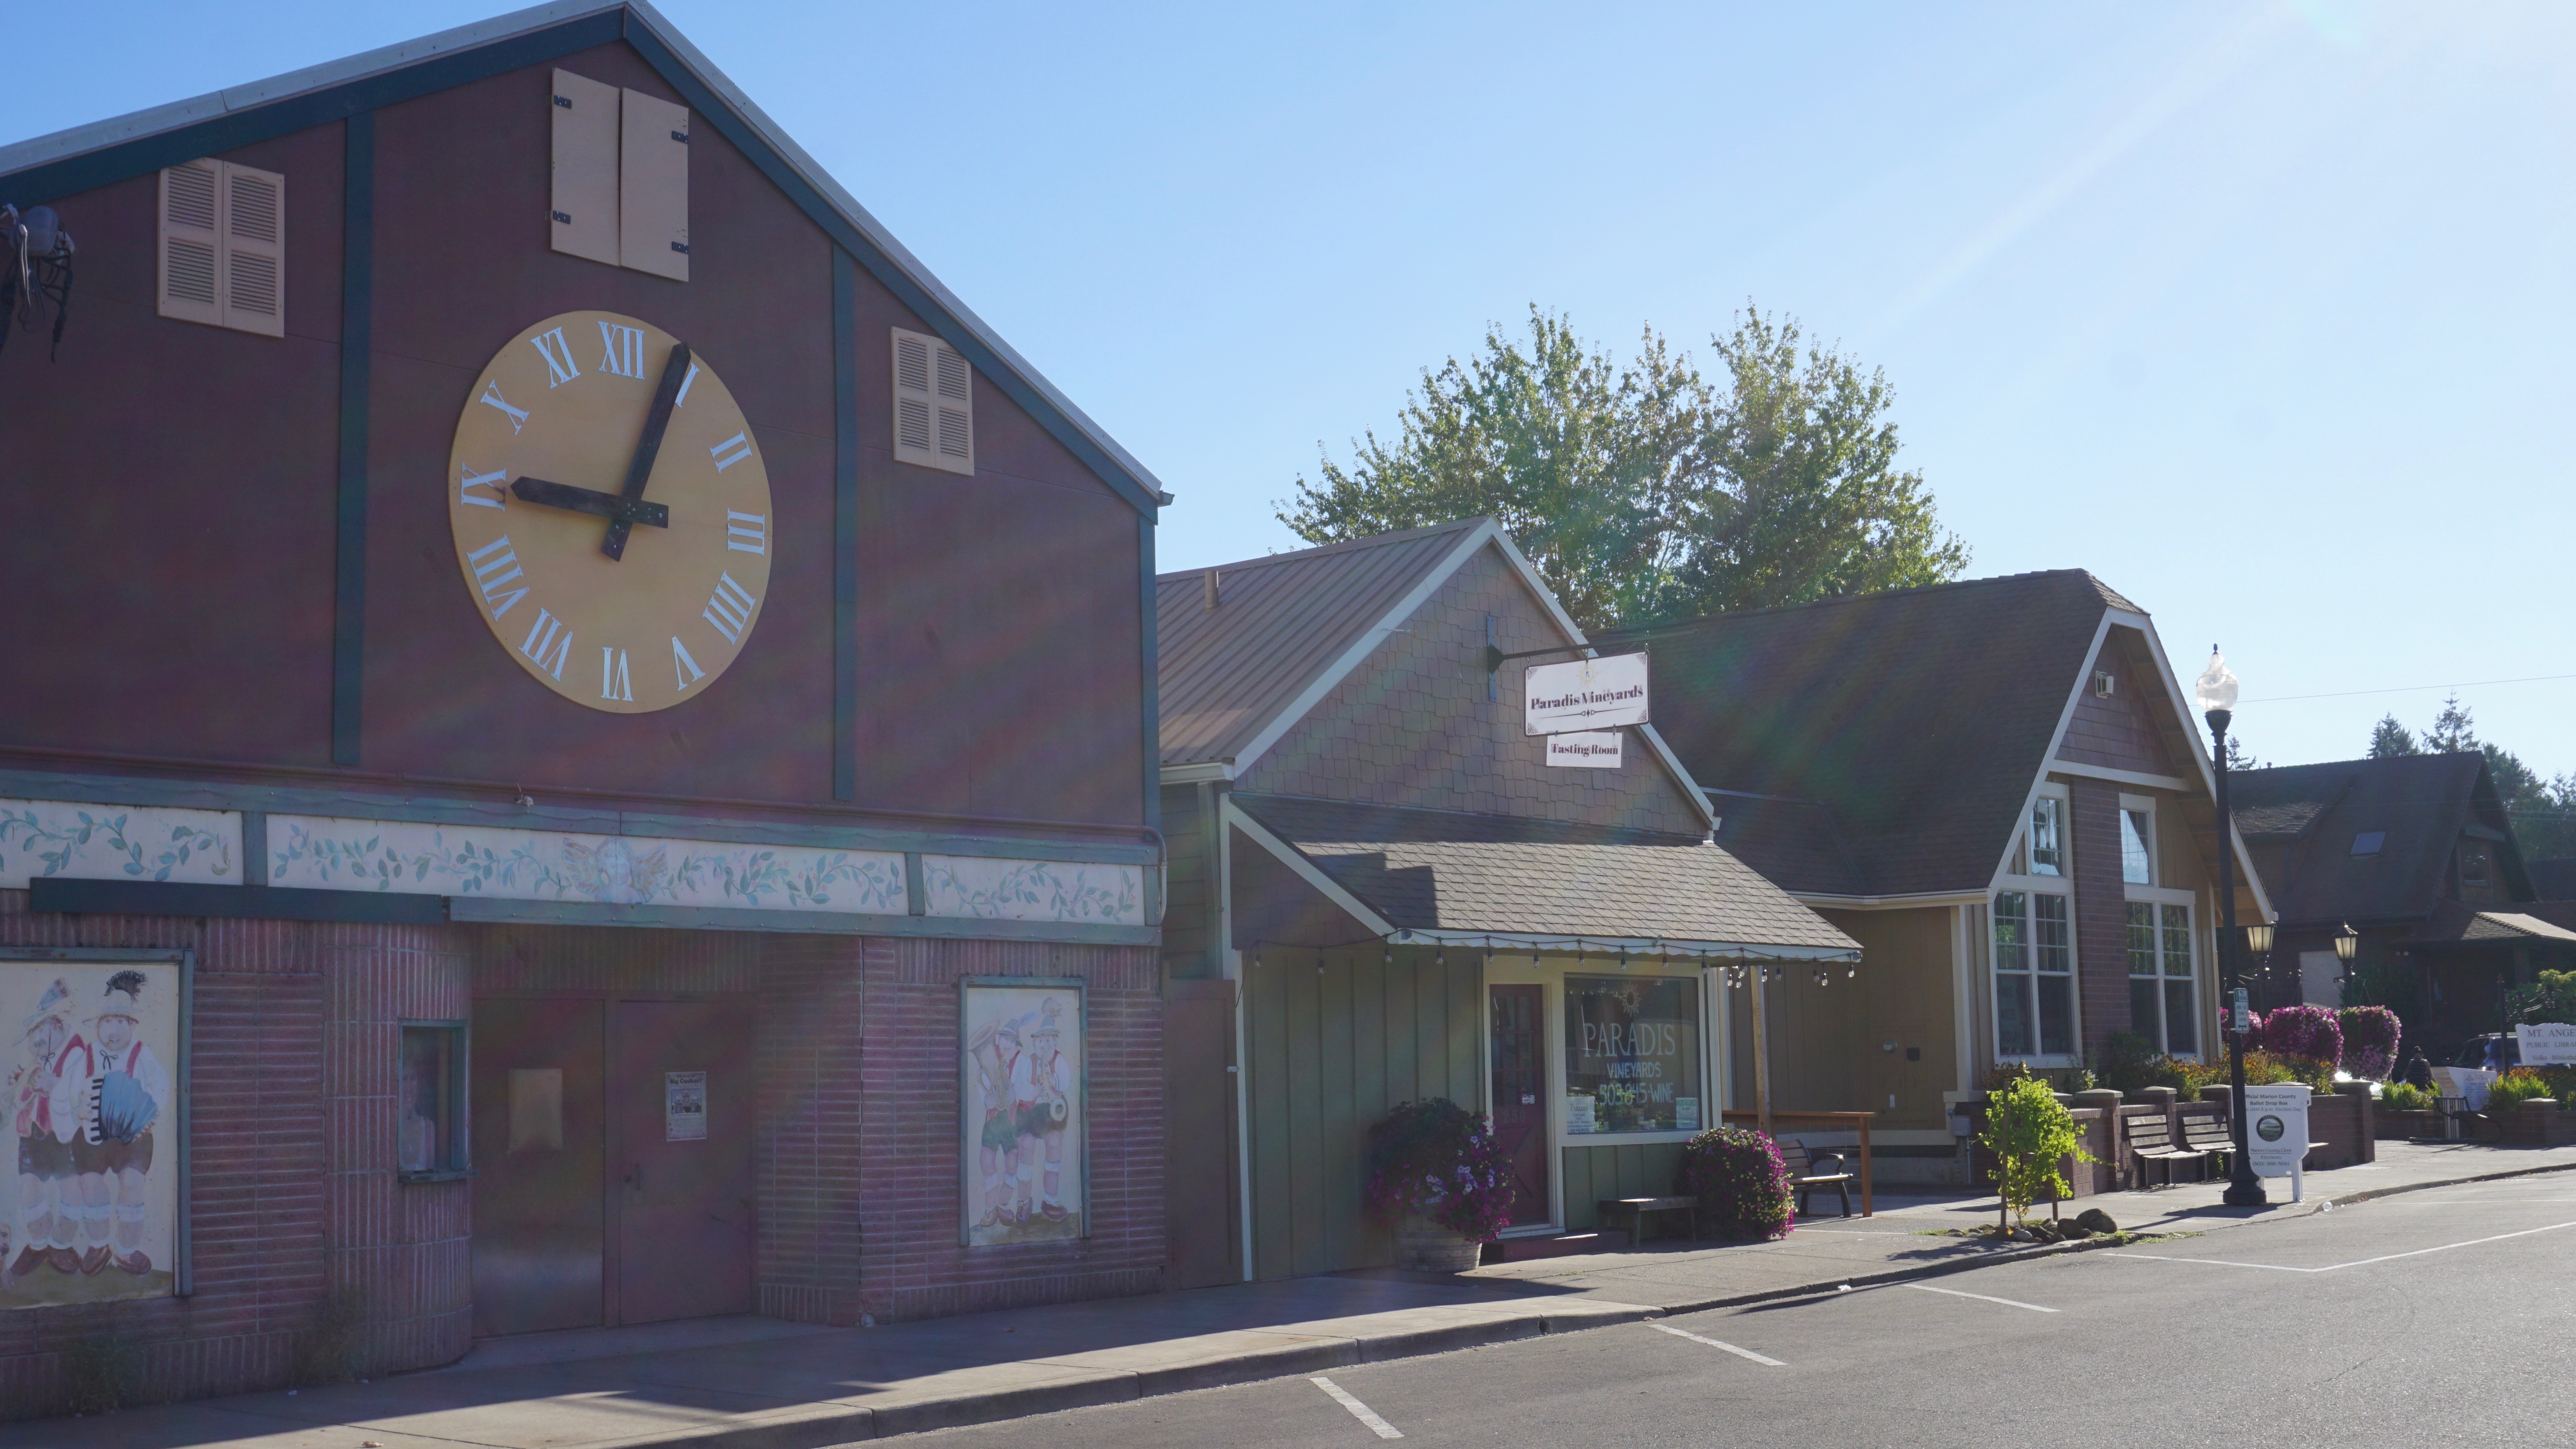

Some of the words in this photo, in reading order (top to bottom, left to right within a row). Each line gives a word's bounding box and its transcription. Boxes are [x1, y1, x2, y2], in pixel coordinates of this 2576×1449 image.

[530, 326, 581, 389] XI
[597, 321, 645, 380] XII
[480, 379, 530, 435] X
[709, 430, 753, 474] II
[461, 462, 506, 512] IX
[727, 508, 765, 556] III
[466, 534, 530, 622] VIII
[701, 570, 756, 646] IIII
[518, 607, 573, 682] VII
[671, 636, 706, 691] V
[601, 647, 634, 702] VI
[1531, 694, 1580, 710] Paradis
[1582, 685, 1643, 705] Vineyards
[1551, 743, 1590, 757] Tasting
[1591, 744, 1618, 755] Room
[1583, 1022, 1676, 1057] PARADIS
[2527, 1029, 2544, 1037] MT.
[1607, 1061, 1662, 1079] VINEYARDS
